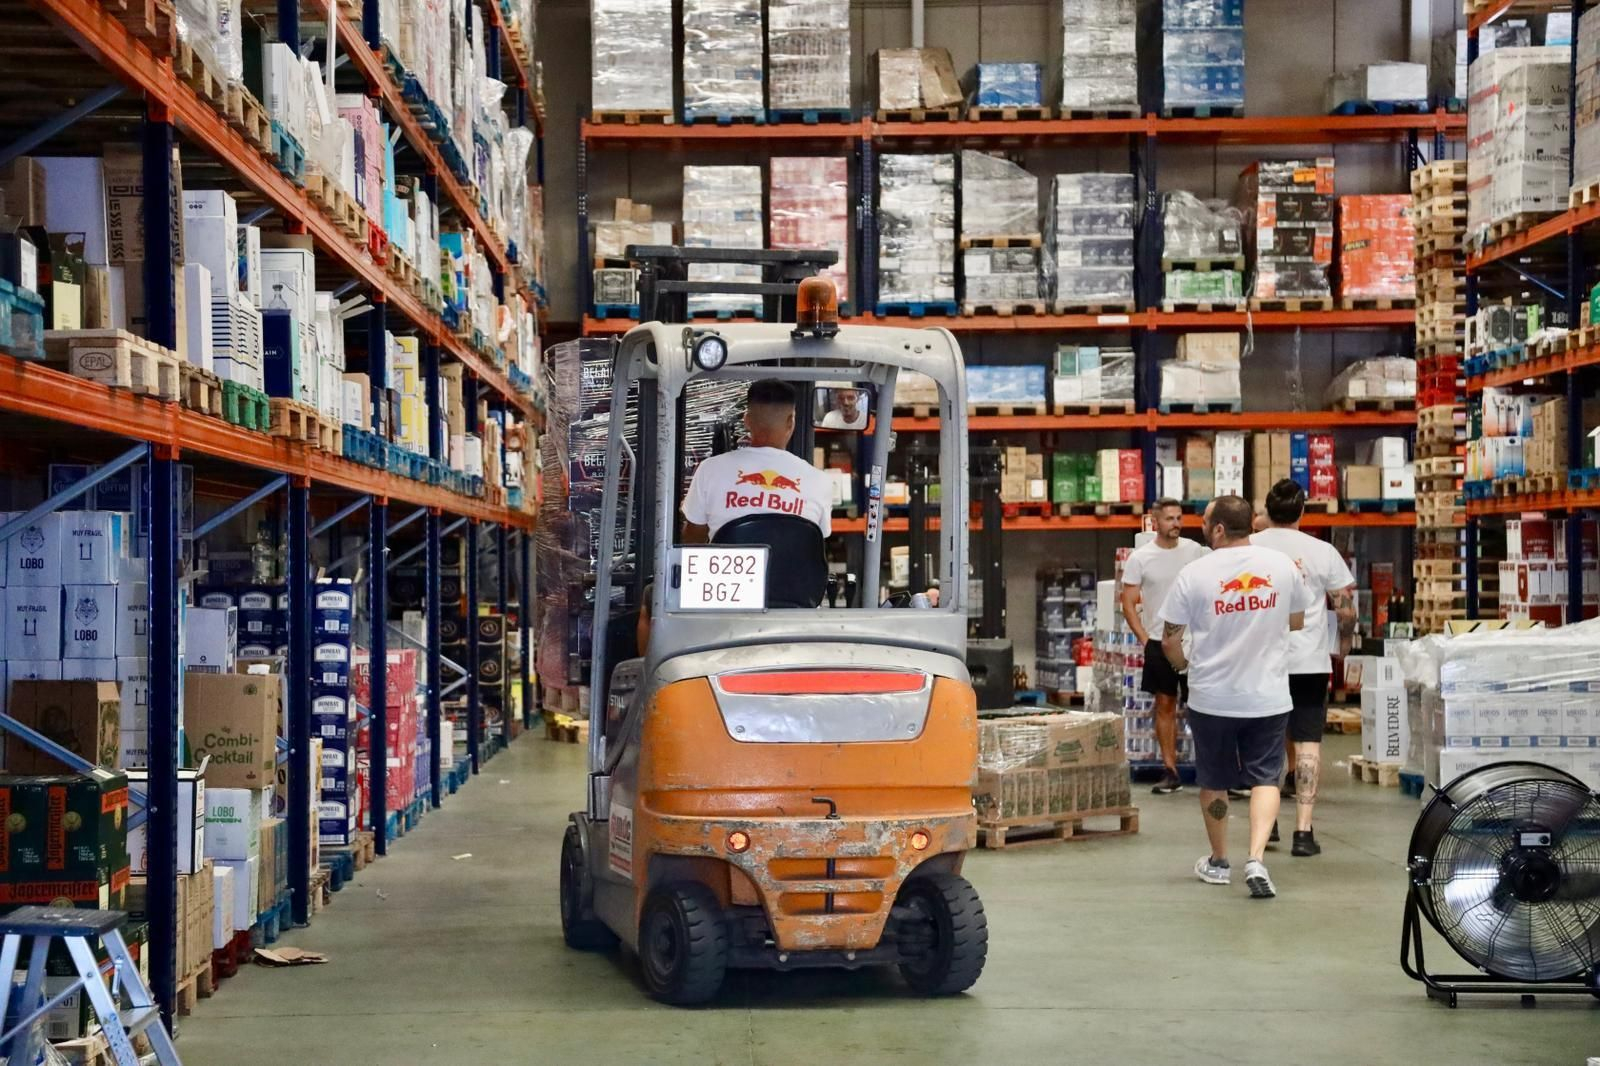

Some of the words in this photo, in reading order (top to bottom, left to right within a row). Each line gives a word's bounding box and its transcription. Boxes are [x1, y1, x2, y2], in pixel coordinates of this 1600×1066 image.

[725, 491, 765, 509] Red
[767, 493, 804, 515] Bull
[20, 558, 44, 569] LOBO
[687, 555, 699, 575] E
[709, 555, 756, 575] 6282
[702, 583, 741, 602] BGZ
[1214, 596, 1246, 615] Red
[1248, 592, 1277, 611] Bull
[74, 629, 98, 641] LOBO
[610, 694, 625, 708] STILL
[1386, 695, 1400, 757] BELVEDERE
[204, 733, 260, 749] Combi-
[194, 748, 253, 764] Cocktail
[212, 806, 235, 817] LOBO
